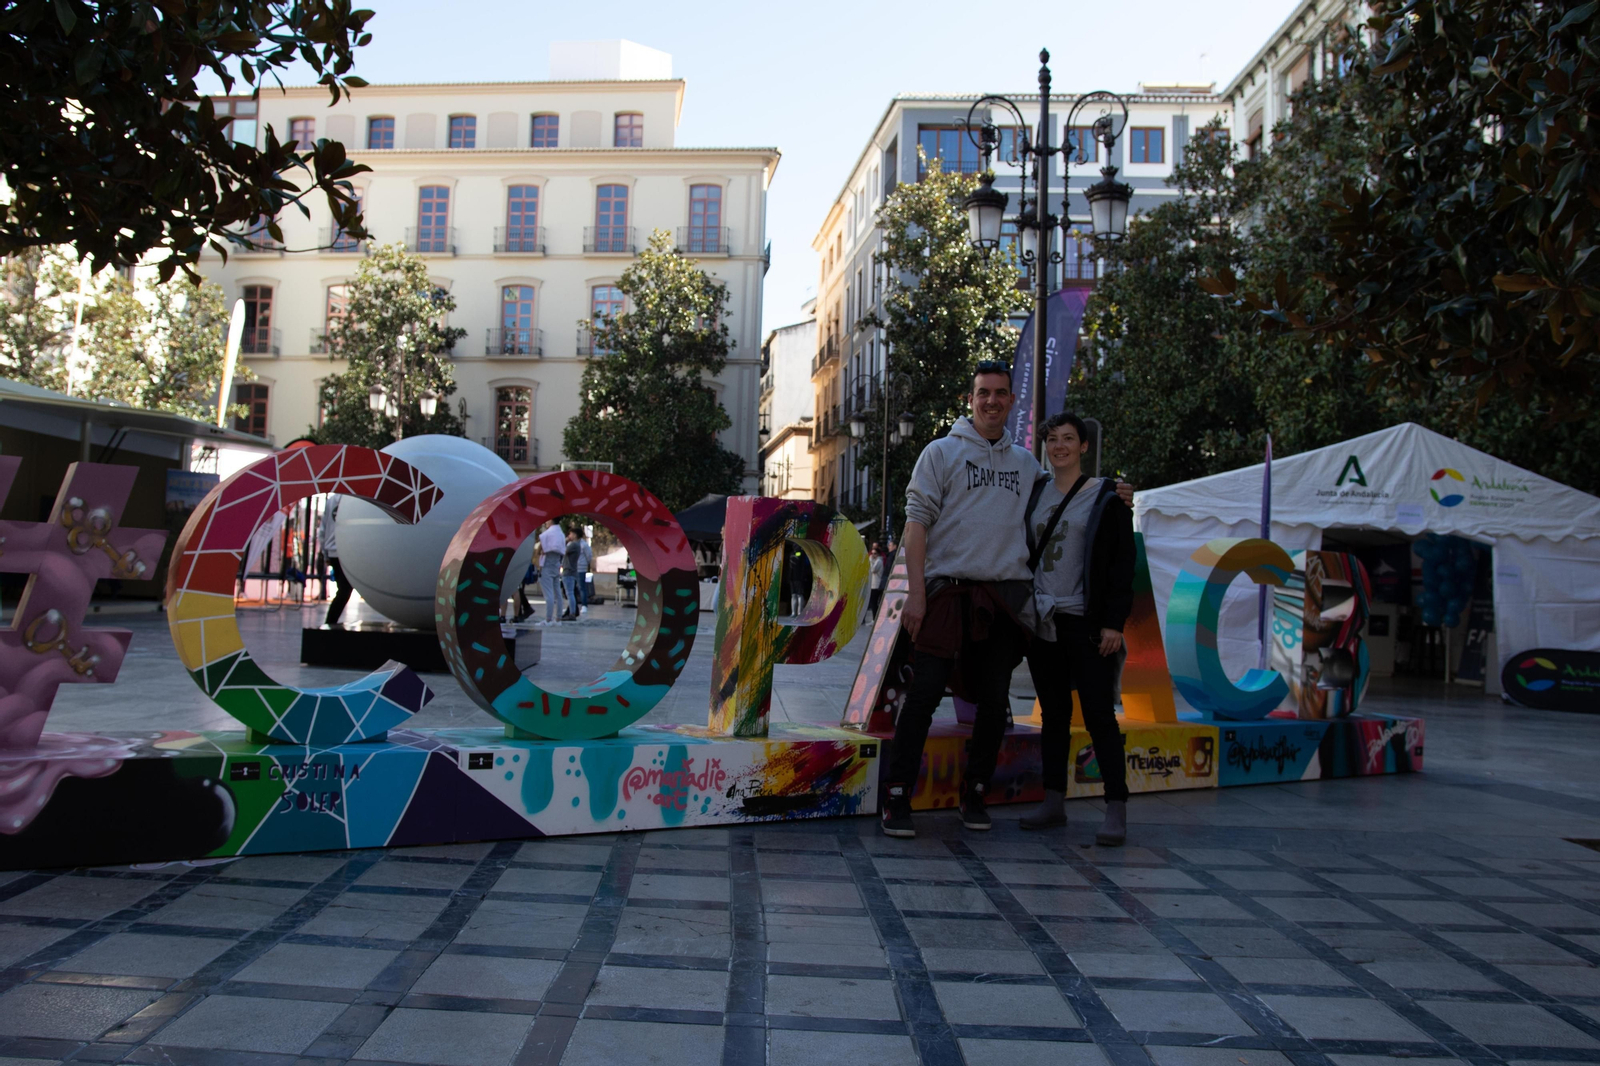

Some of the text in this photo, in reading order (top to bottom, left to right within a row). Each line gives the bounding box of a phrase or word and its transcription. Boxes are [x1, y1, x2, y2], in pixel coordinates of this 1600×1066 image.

[965, 459, 1021, 497] TEAM PEPE
[1316, 489, 1338, 497] Junta
[268, 762, 361, 782] CRISTINA
[279, 790, 342, 815] SOLER
